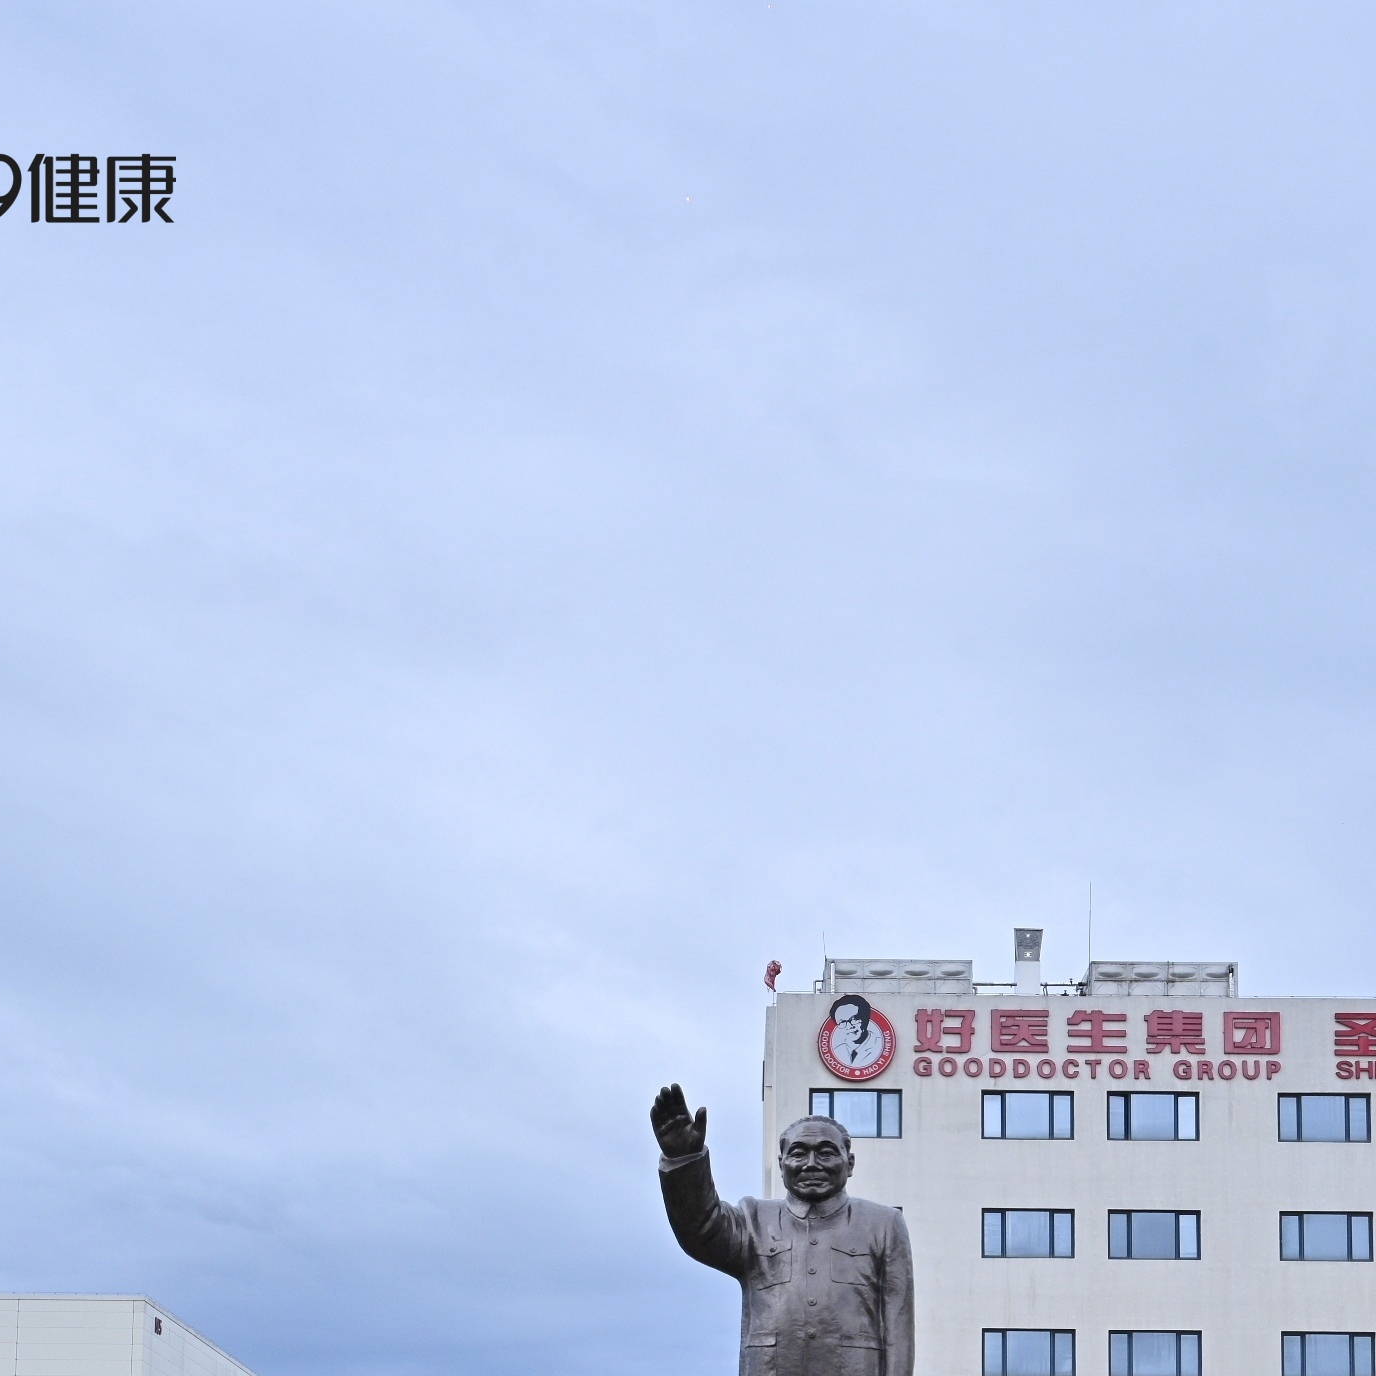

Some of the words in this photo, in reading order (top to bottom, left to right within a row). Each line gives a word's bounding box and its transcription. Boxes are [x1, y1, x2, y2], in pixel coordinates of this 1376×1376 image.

[824, 1052, 851, 1075] DOCTOR
[862, 1064, 879, 1075] HAO
[877, 1057, 886, 1065] YI
[883, 1030, 892, 1057] SHENG
[914, 1009, 1280, 1054] 好医生集团
[913, 1057, 1151, 1079] GOODDOCTOR
[1173, 1060, 1282, 1079] GROUP
